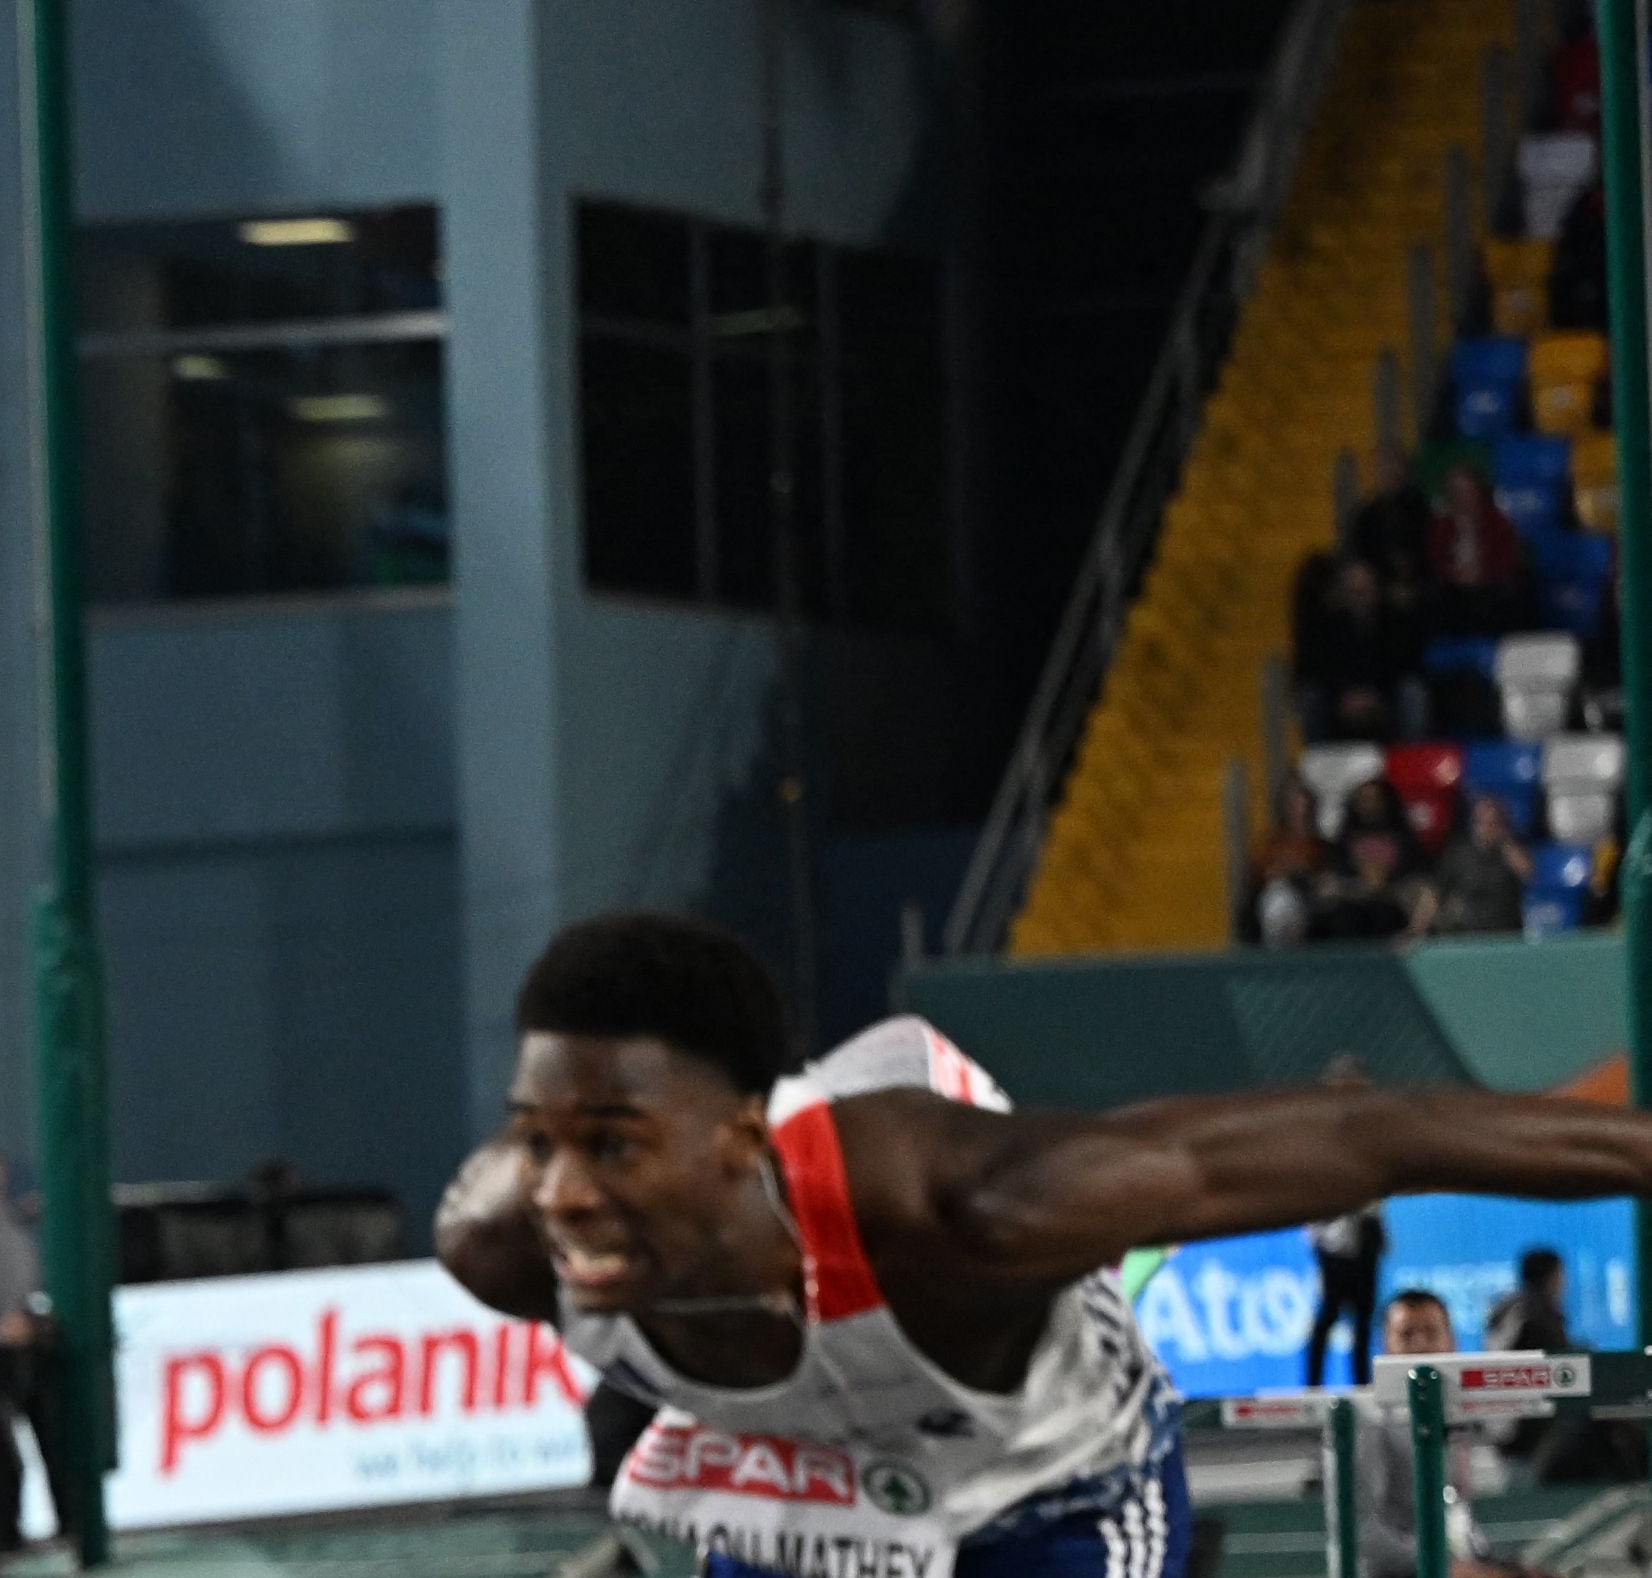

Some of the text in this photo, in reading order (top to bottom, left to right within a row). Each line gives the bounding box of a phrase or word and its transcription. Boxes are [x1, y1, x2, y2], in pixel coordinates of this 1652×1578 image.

[159, 1305, 586, 1476] polanik
[1484, 1364, 1552, 1388] SPAR
[631, 1428, 850, 1498] SPAR
